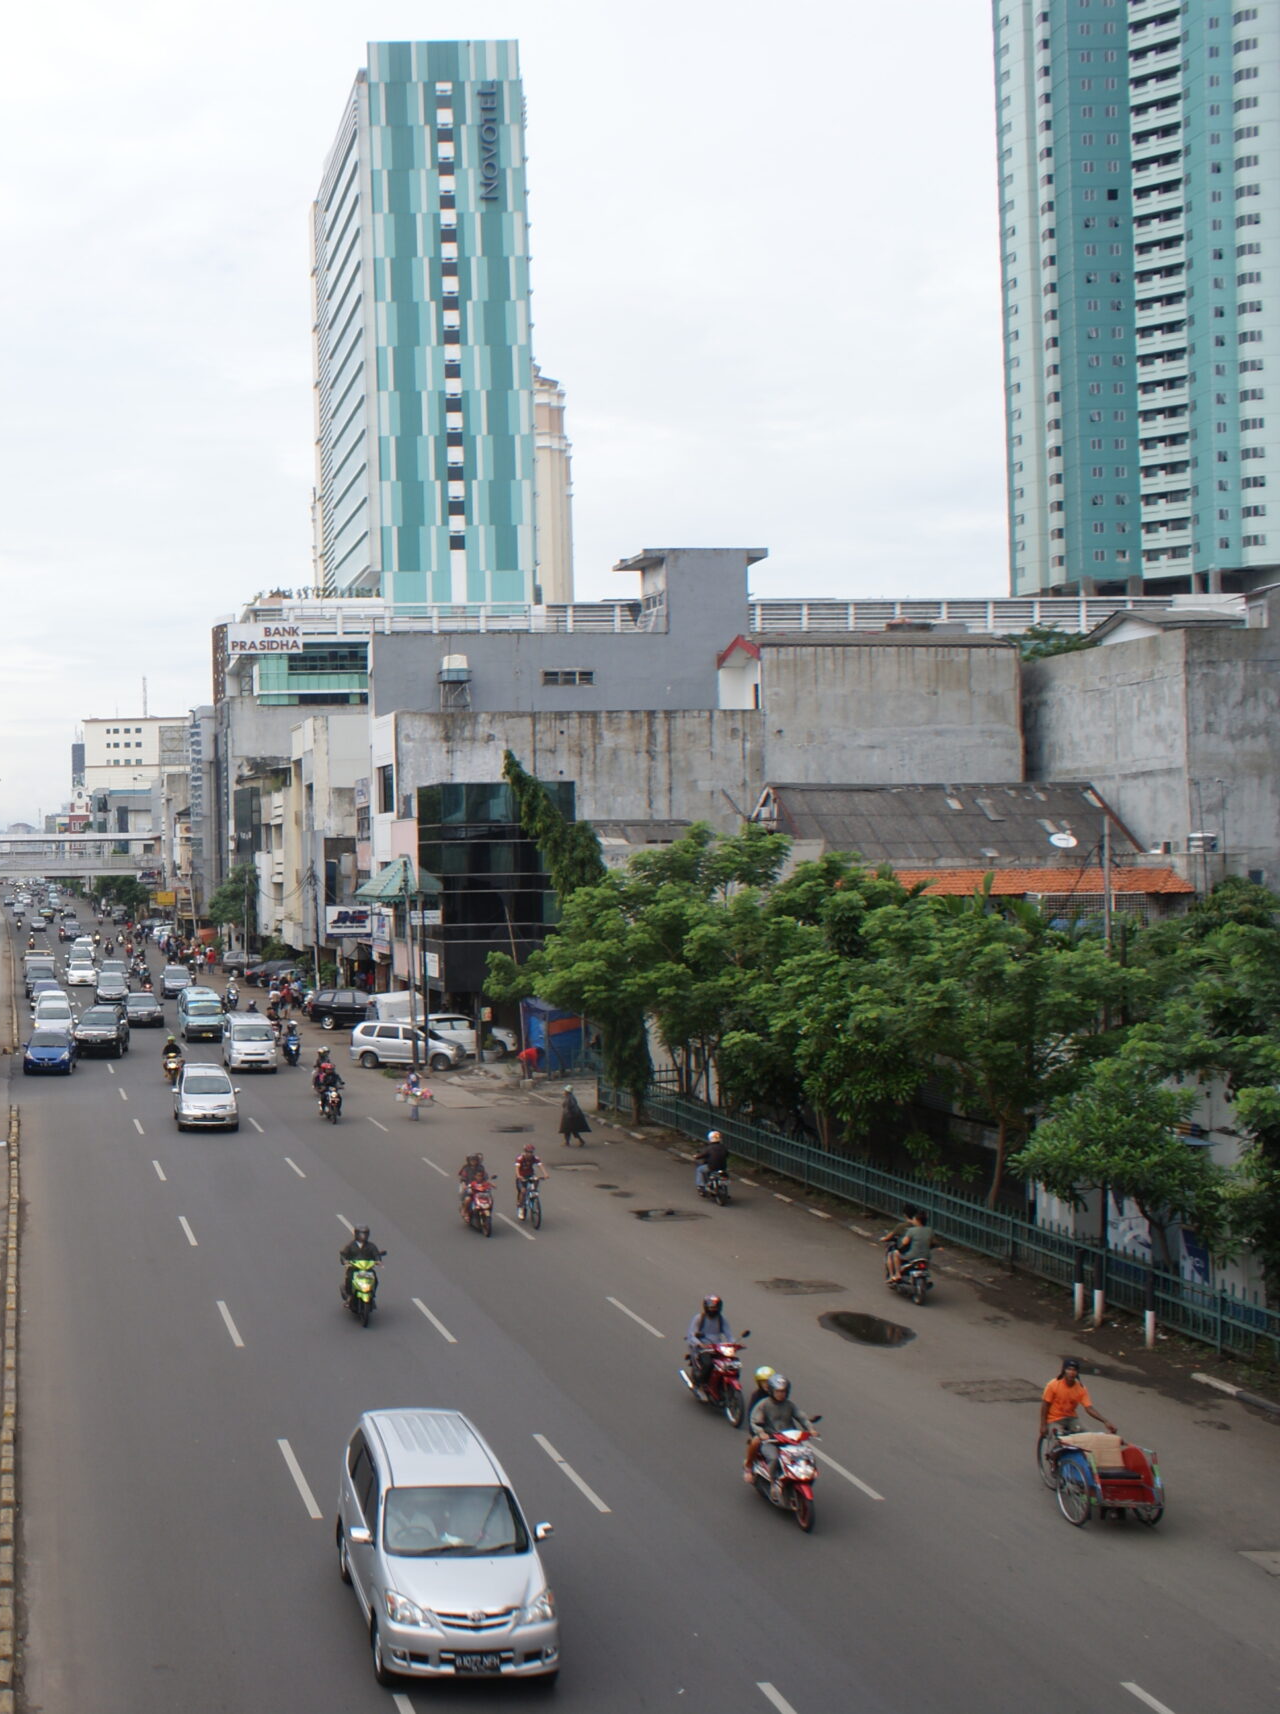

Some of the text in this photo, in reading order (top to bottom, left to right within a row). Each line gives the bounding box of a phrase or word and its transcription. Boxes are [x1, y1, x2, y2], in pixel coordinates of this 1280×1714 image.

[477, 79, 499, 202] NOVOTEL
[263, 627, 300, 638] BANK
[231, 640, 301, 651] PRASIDHA
